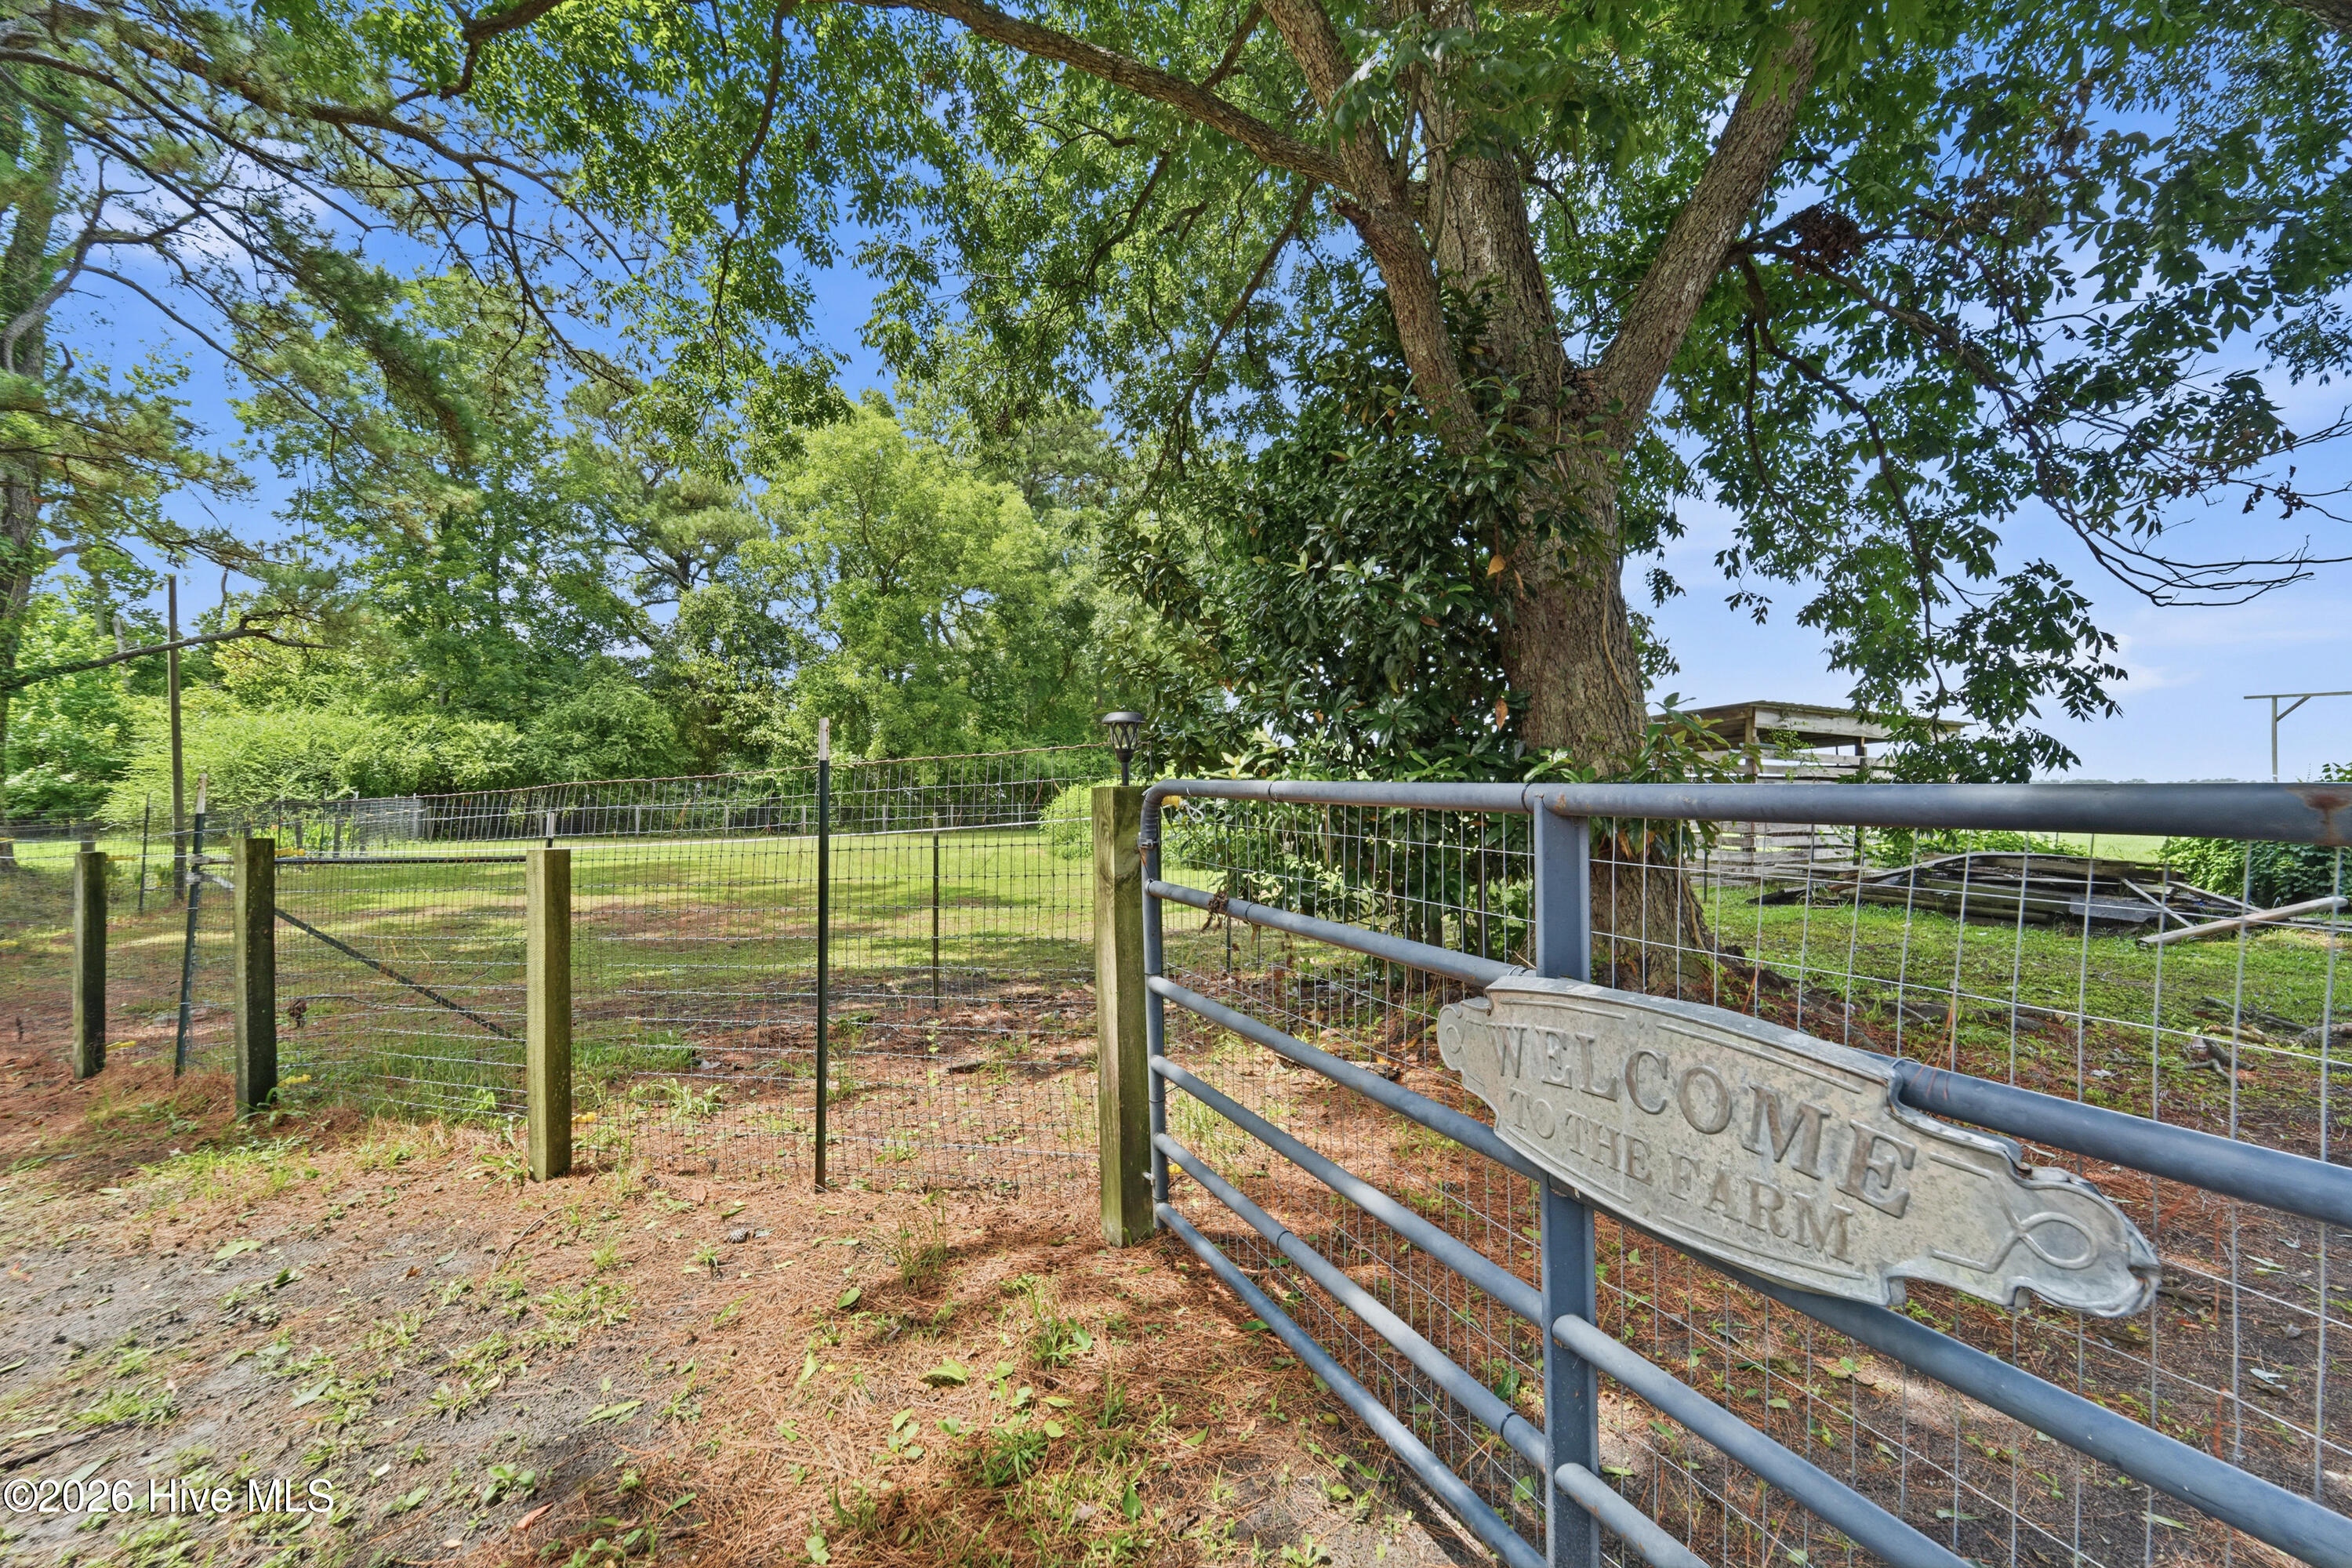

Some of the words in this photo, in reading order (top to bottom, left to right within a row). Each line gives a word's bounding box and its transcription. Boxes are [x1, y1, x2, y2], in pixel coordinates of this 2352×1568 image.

[1485, 1023, 1916, 1219] WELCOME
[1508, 1087, 1555, 1139] TO
[1566, 1109, 1654, 1185] THE
[1668, 1151, 1853, 1257] FARM
